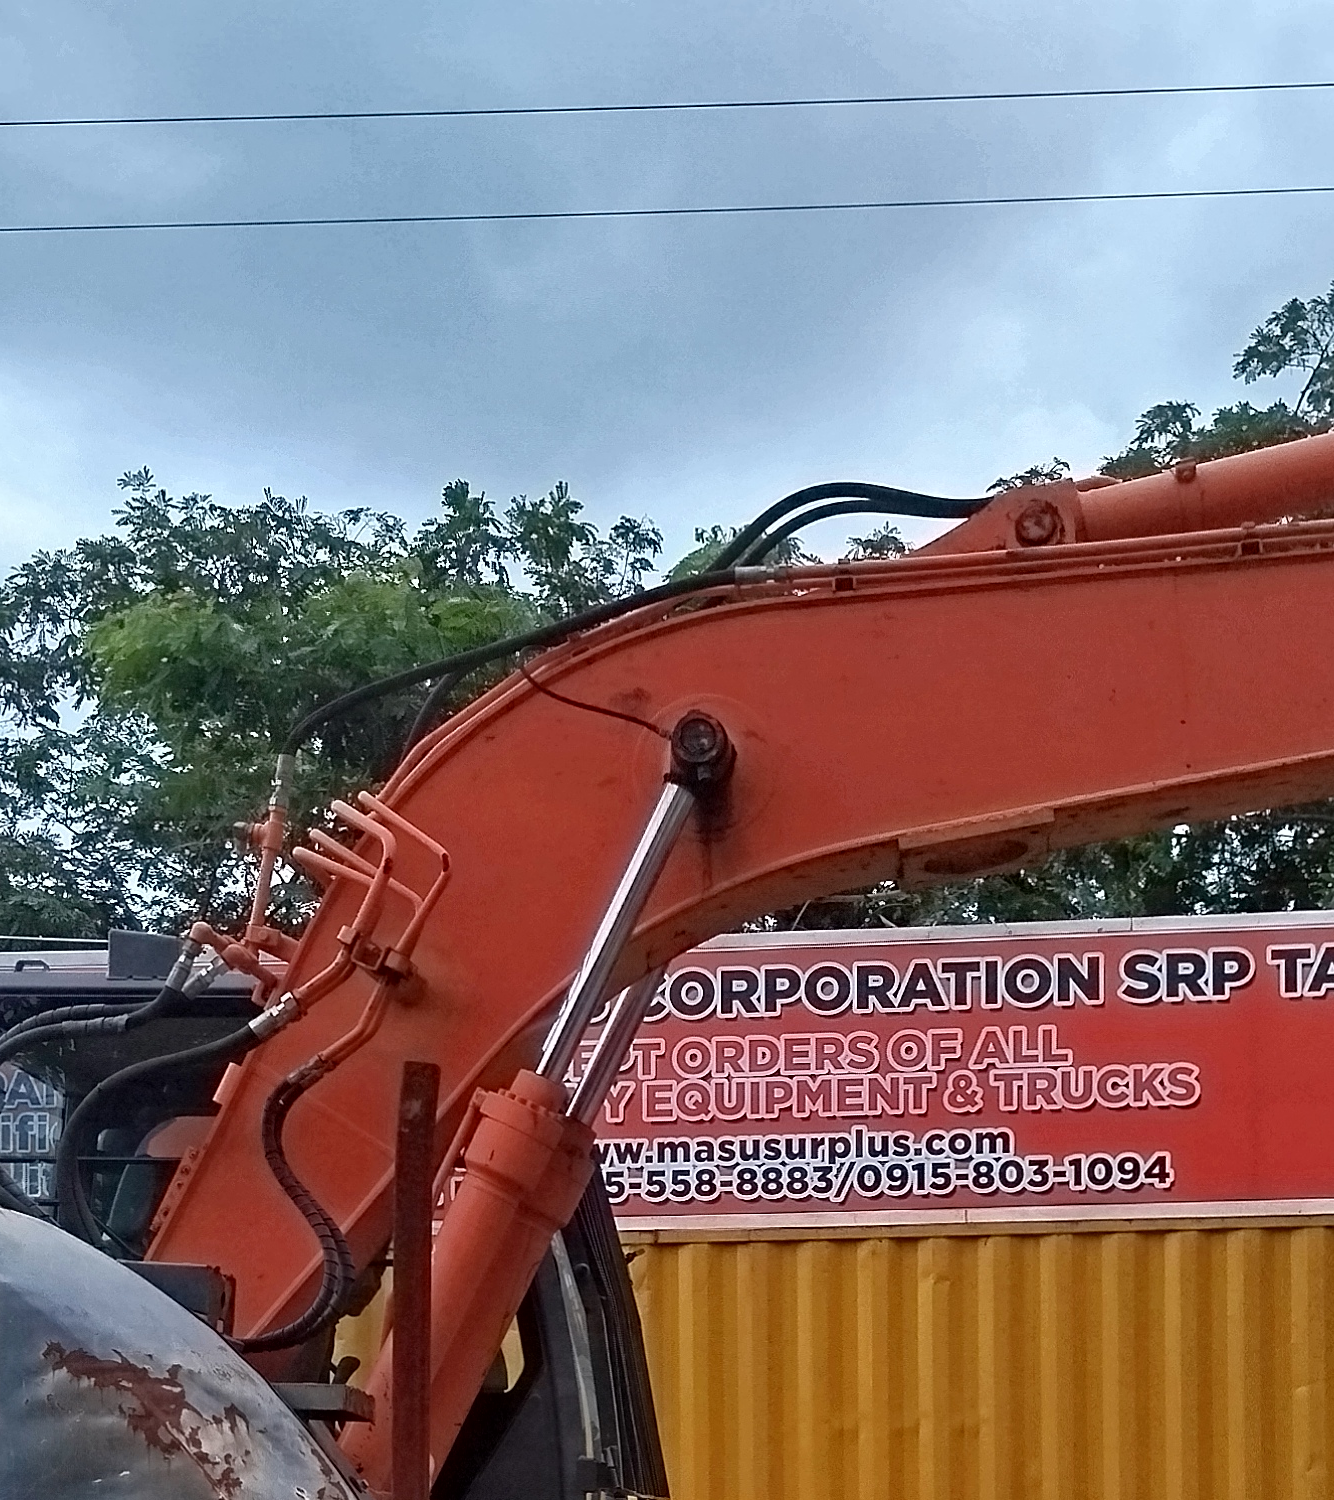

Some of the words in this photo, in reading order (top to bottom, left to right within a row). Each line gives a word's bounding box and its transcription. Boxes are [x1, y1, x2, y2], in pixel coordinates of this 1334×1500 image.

[1119, 945, 1251, 1005] SRP
[672, 1032, 880, 1079] ORDERS
[886, 1028, 965, 1072] OF
[970, 1024, 1073, 1069] ALL
[642, 1072, 937, 1123] EQUIPMENT
[943, 1069, 984, 1114] &
[988, 1063, 1201, 1110] TRUCKS
[604, 1154, 1172, 1204] 5-558-8883/0915-803-1094
